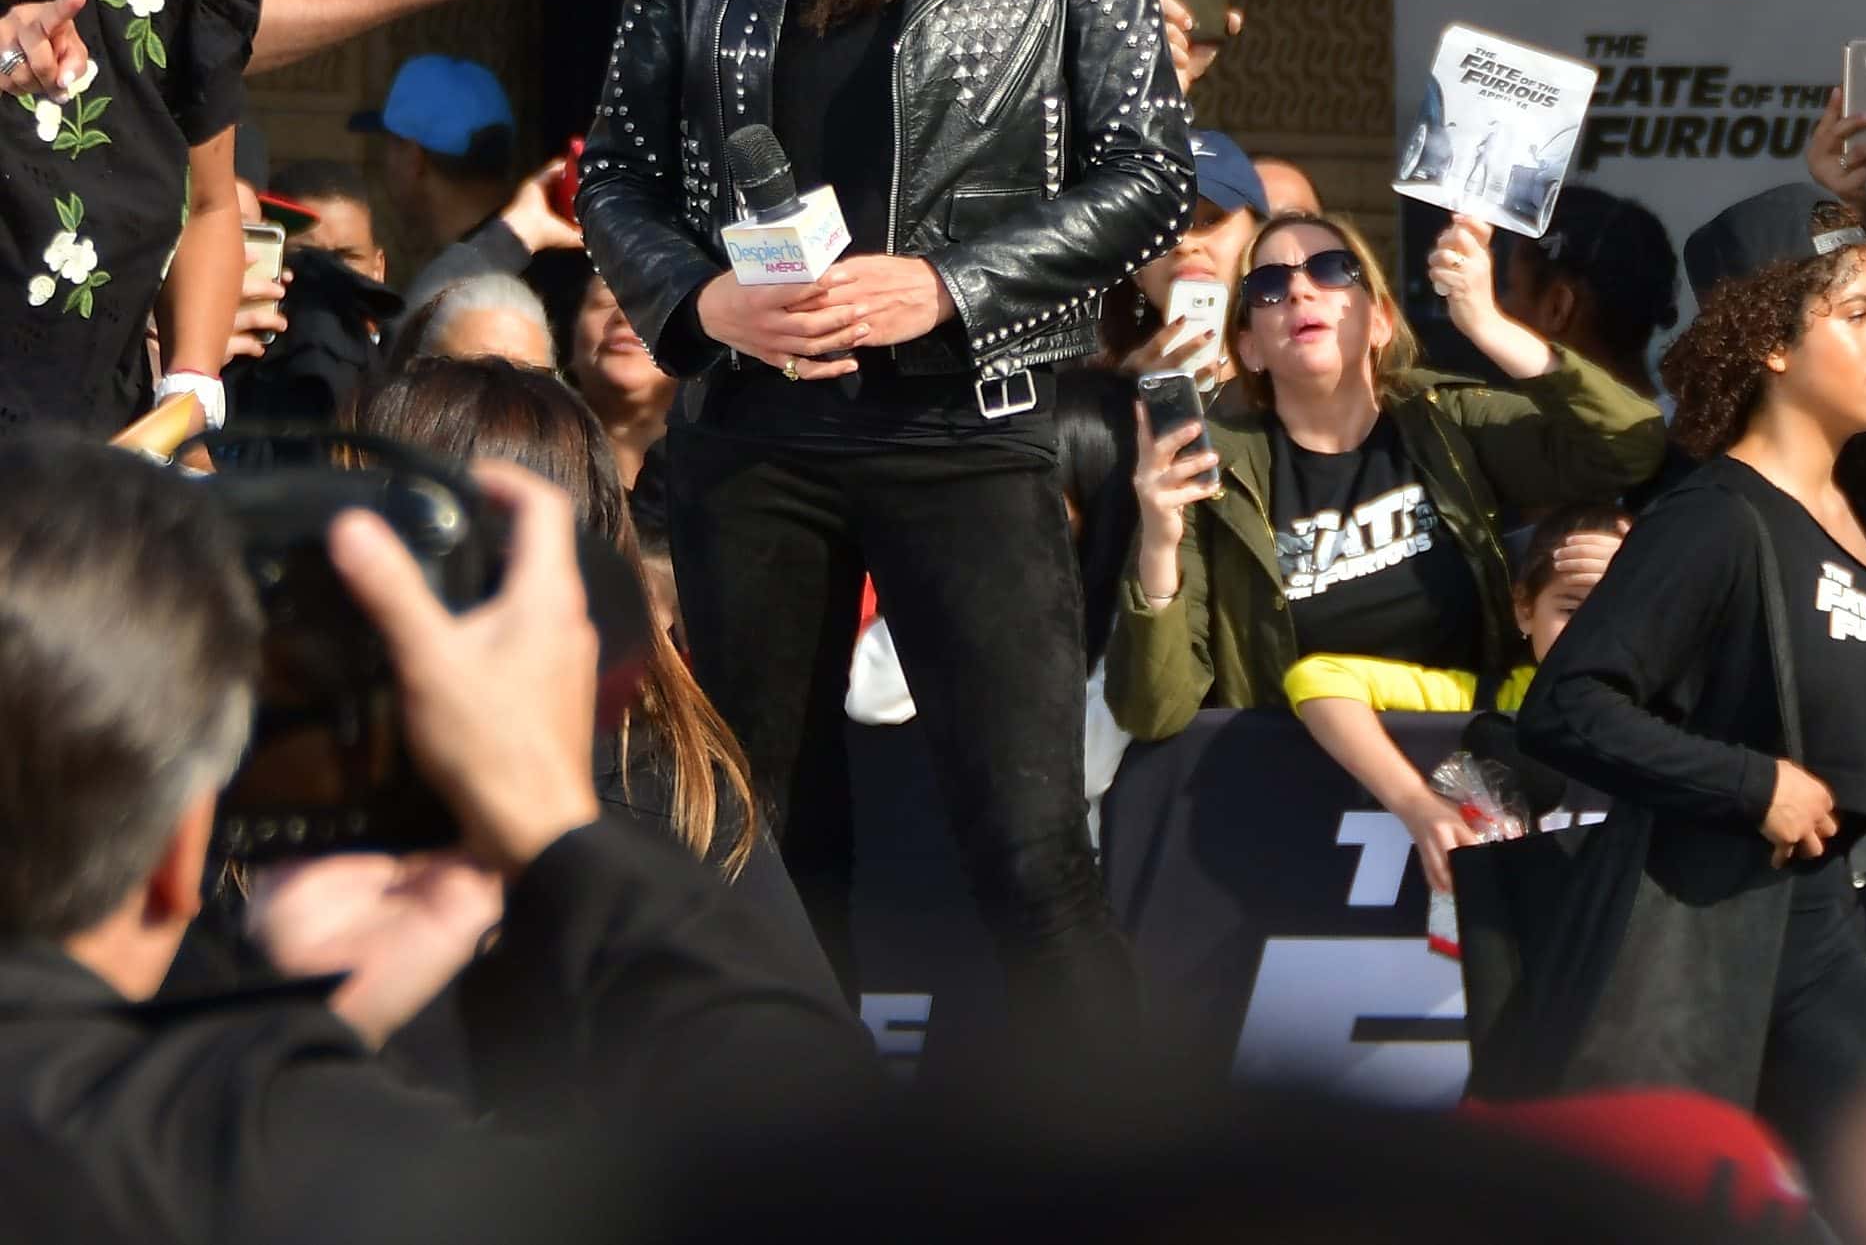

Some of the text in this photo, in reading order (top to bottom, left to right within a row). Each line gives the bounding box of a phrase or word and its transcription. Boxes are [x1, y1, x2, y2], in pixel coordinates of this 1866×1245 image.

[1474, 47, 1498, 59] THE
[1584, 35, 1648, 58] THE
[1459, 53, 1561, 96] FATE OF THE
[1459, 68, 1559, 109] FURIOUS
[1731, 85, 1775, 108] OF
[1577, 116, 1819, 171] FURIOU
